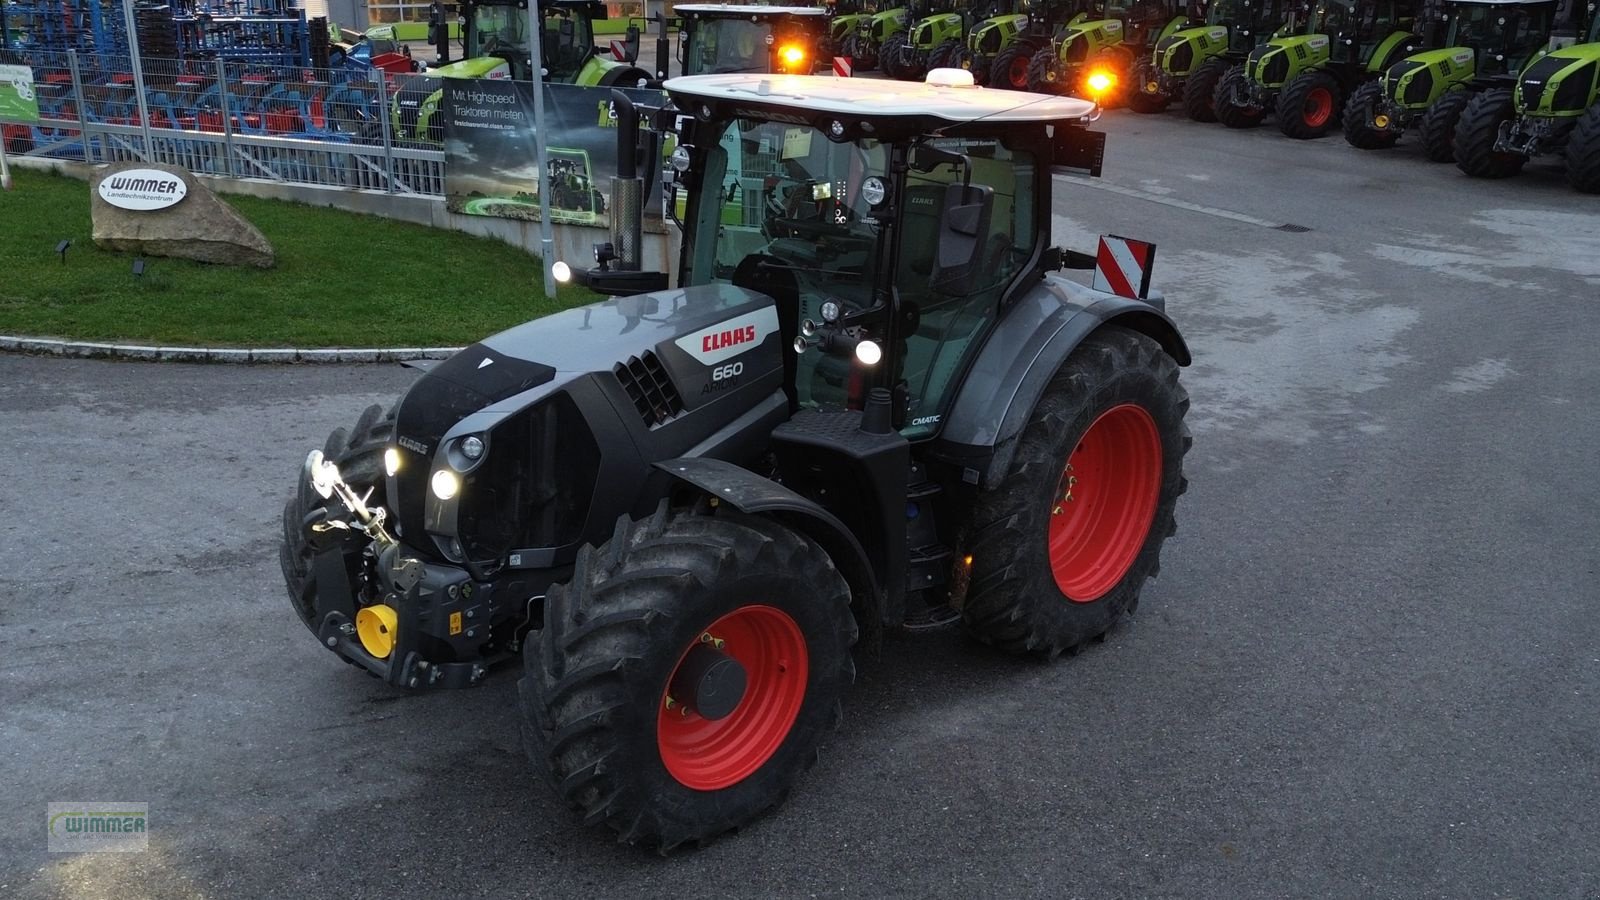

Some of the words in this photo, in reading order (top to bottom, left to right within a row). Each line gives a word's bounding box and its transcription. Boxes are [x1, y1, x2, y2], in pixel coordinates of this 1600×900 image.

[452, 89, 466, 101] Mit
[467, 91, 516, 105] Highspeed
[453, 104, 492, 118] Traktoren
[110, 177, 178, 194] WIMMER
[106, 191, 174, 203] Landtechnikzentrum
[702, 325, 755, 353] CLAAS
[712, 361, 744, 381] 660
[911, 414, 941, 426] CMATIC
[398, 435, 429, 455] CLAAS
